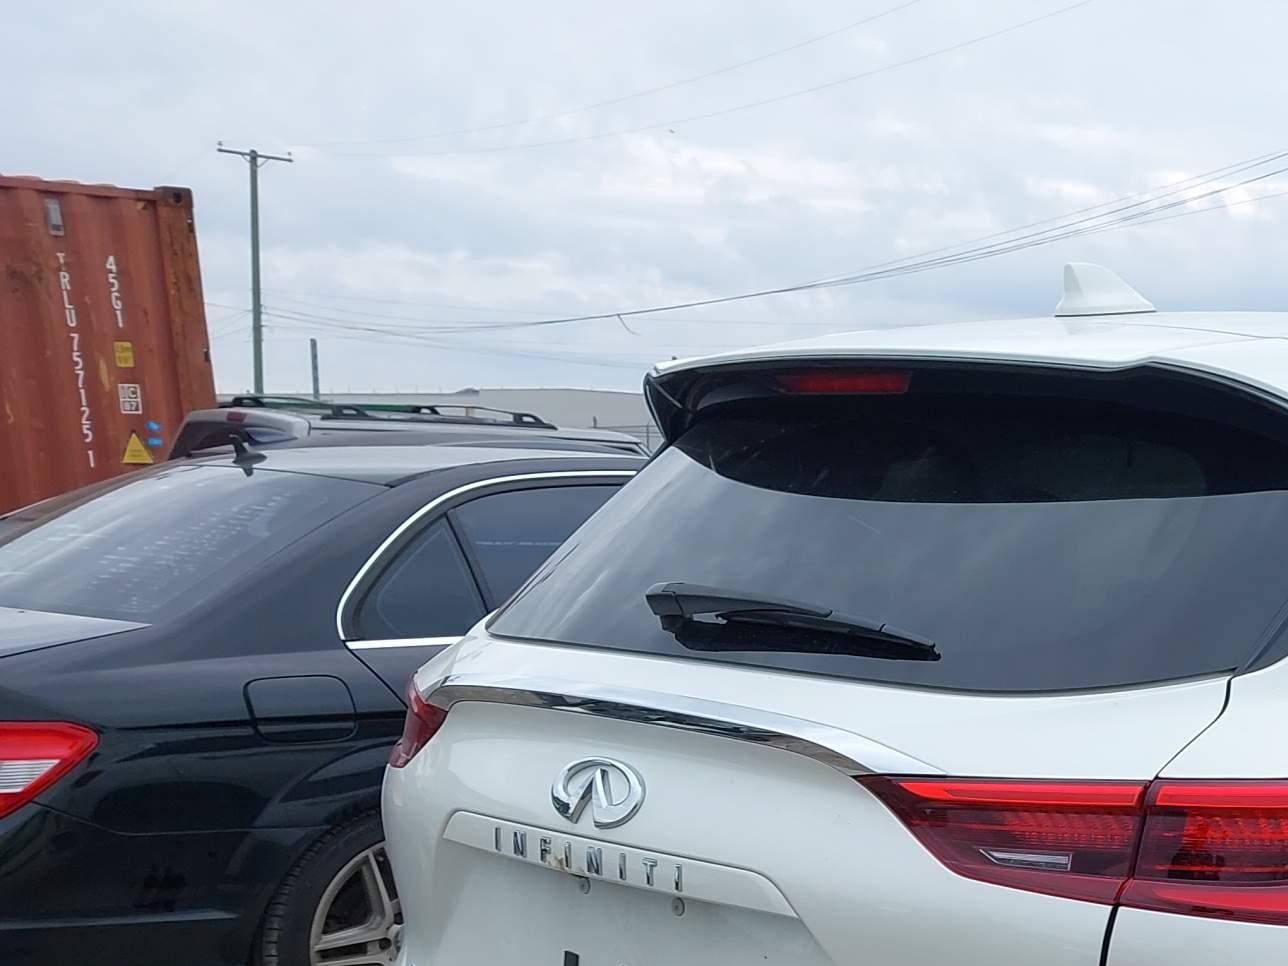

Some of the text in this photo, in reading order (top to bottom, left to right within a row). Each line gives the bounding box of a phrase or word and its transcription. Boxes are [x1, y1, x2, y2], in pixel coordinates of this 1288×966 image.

[56, 252, 77, 327] TRLU
[69, 333, 93, 443] 757125
[495, 827, 683, 892] INFINITI
